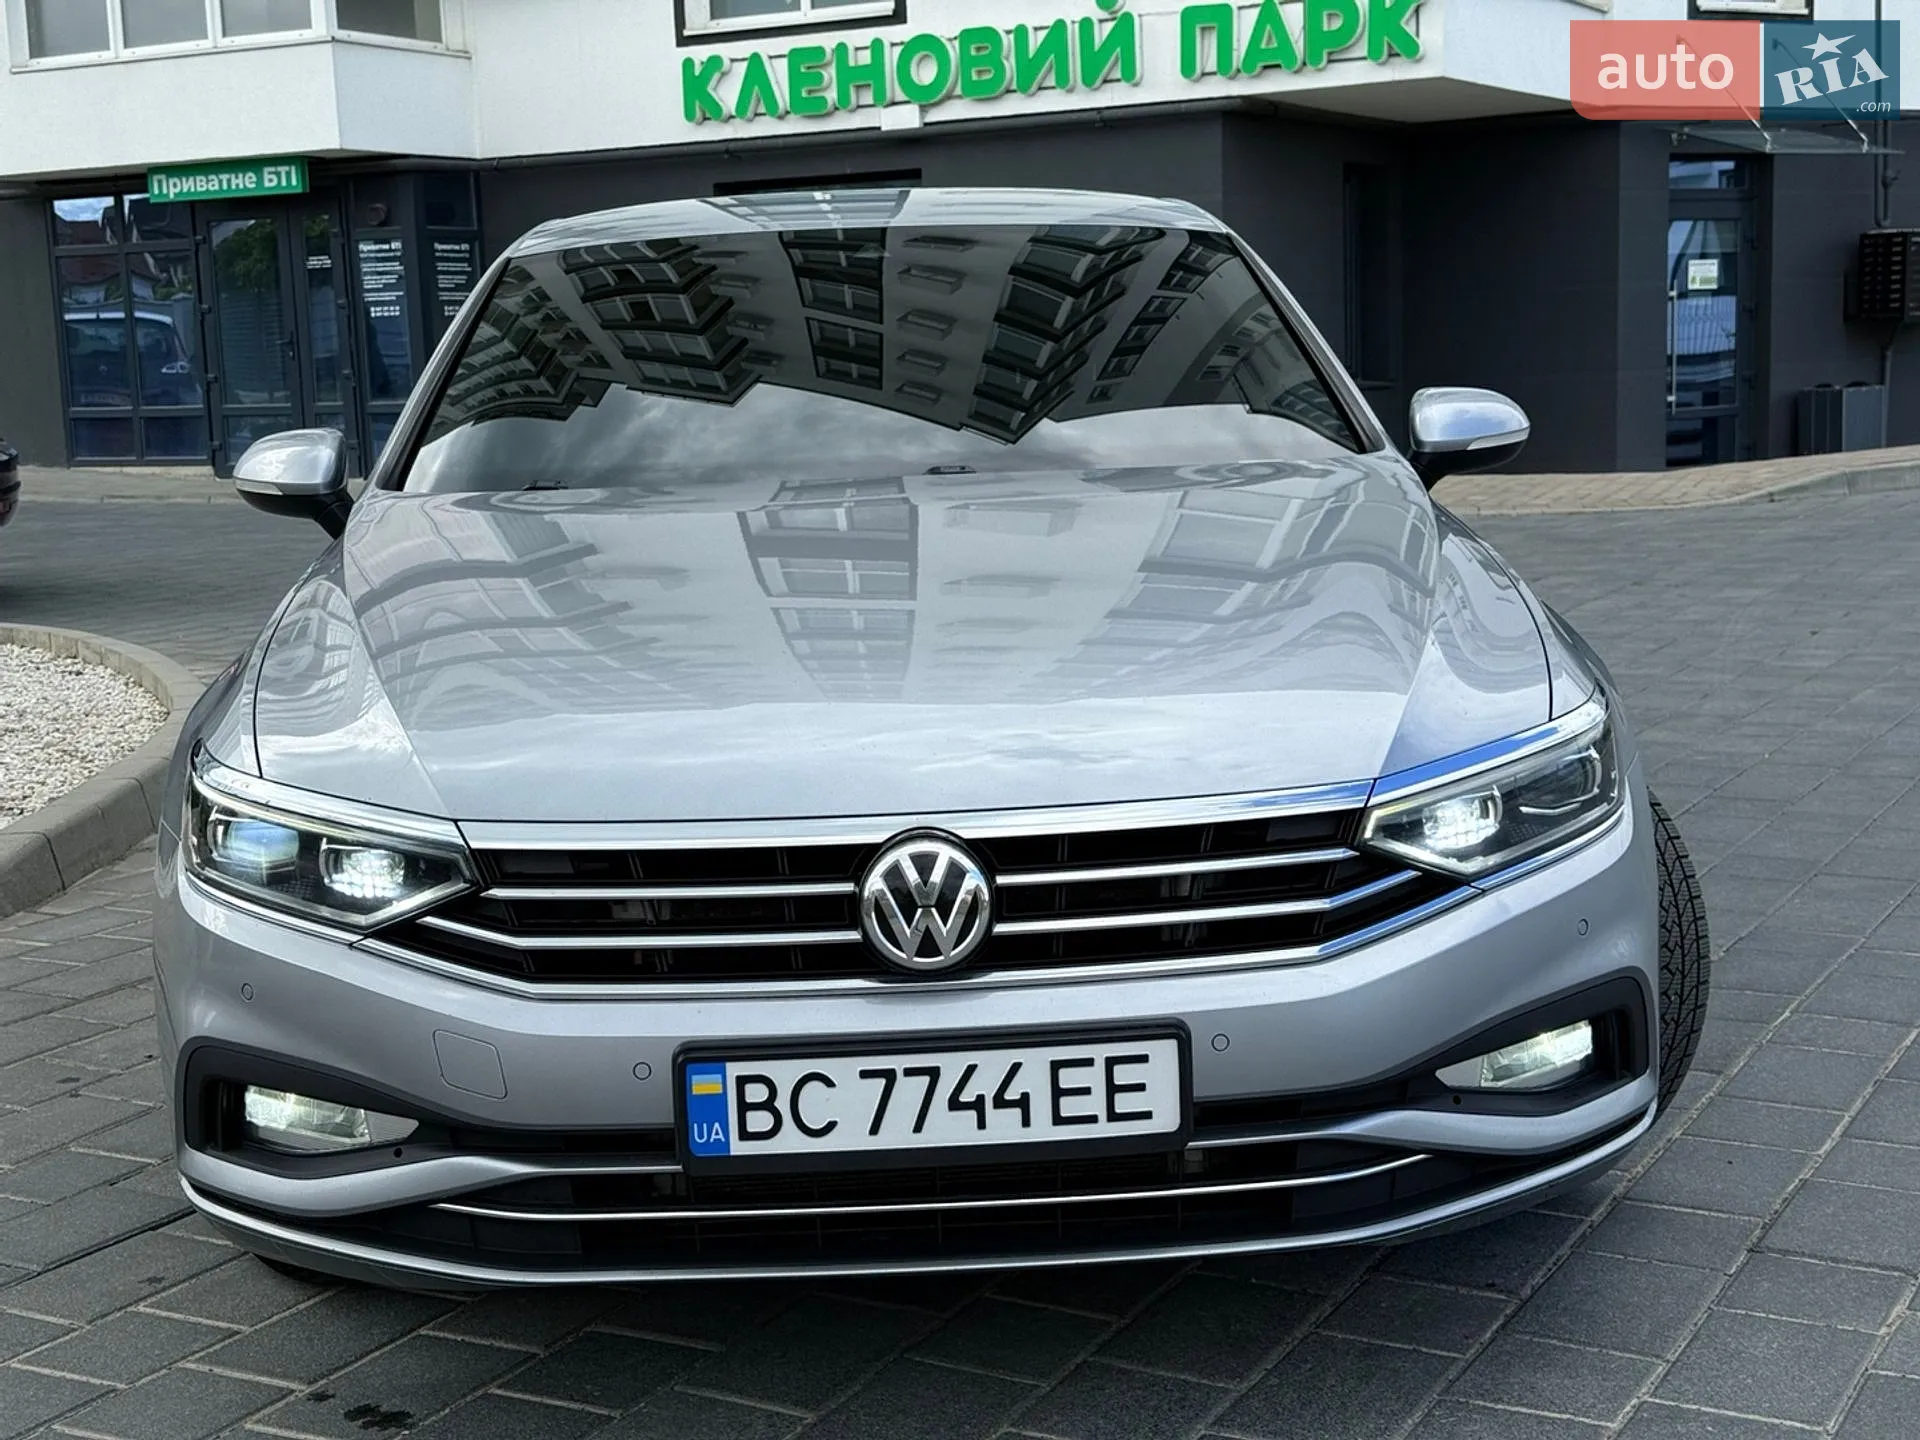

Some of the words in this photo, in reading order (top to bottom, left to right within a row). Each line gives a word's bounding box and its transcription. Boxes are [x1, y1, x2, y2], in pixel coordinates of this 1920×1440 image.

[681, 0, 1140, 123] КЛЕНОВИЙ
[1180, 0, 1422, 80] ПАРК
[152, 171, 257, 199] Приватне
[263, 165, 298, 188] БТІ
[858, 1061, 1032, 1137] 7744
[692, 1122, 726, 1144] UA
